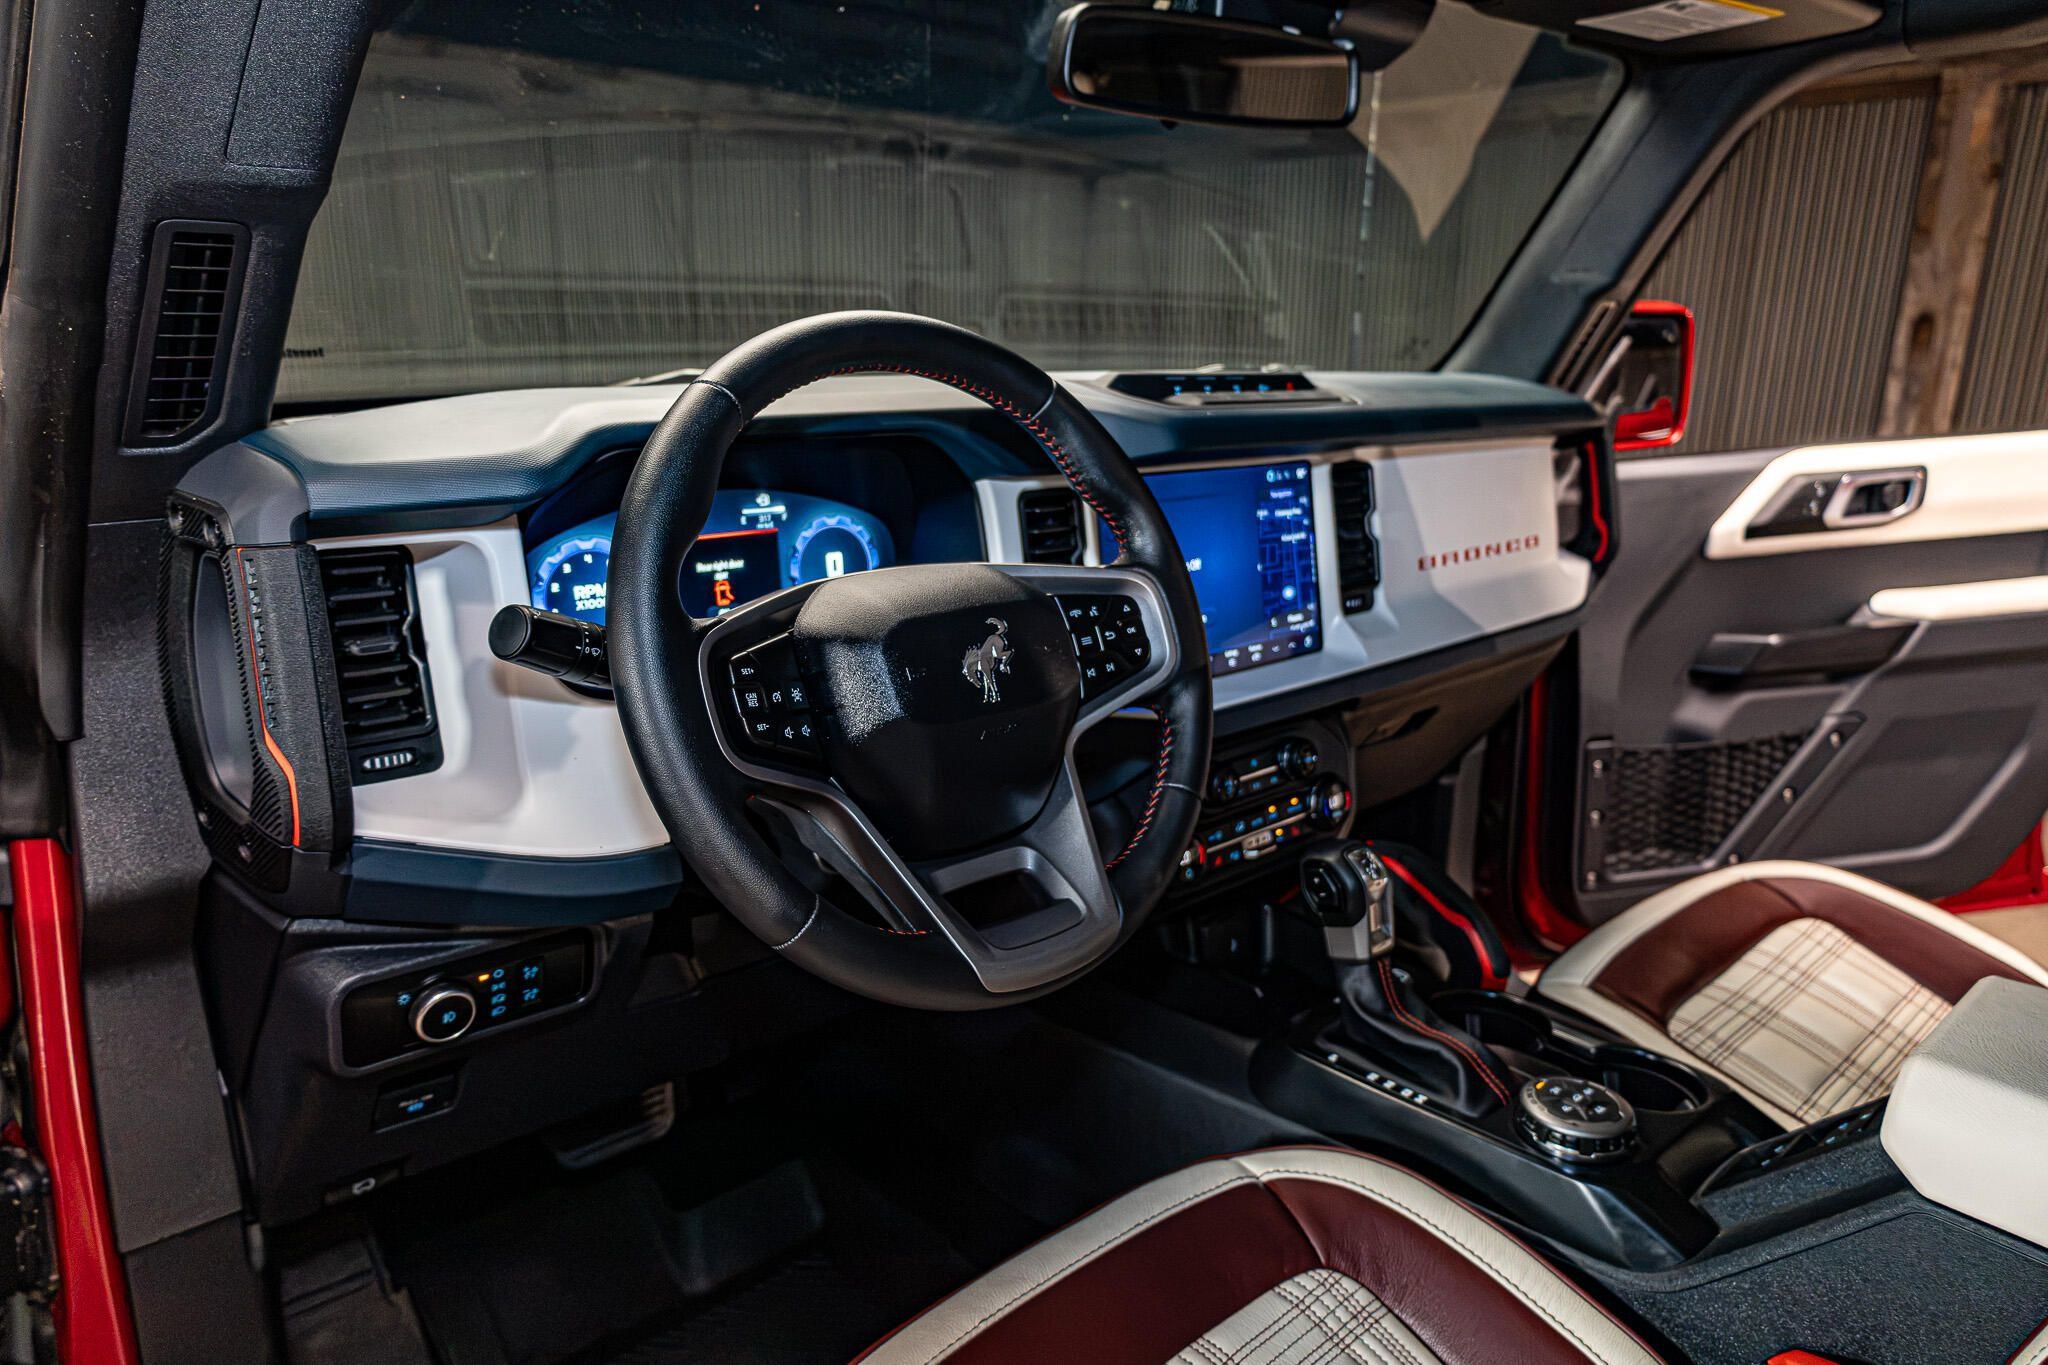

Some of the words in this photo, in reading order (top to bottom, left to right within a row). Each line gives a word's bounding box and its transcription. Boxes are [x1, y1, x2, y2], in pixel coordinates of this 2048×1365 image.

[1418, 534, 1539, 571] BRONCO
[562, 562, 571, 574] 3
[1126, 626, 1137, 634] OK
[745, 692, 757, 700] CAN
[756, 723, 769, 731] SET-
